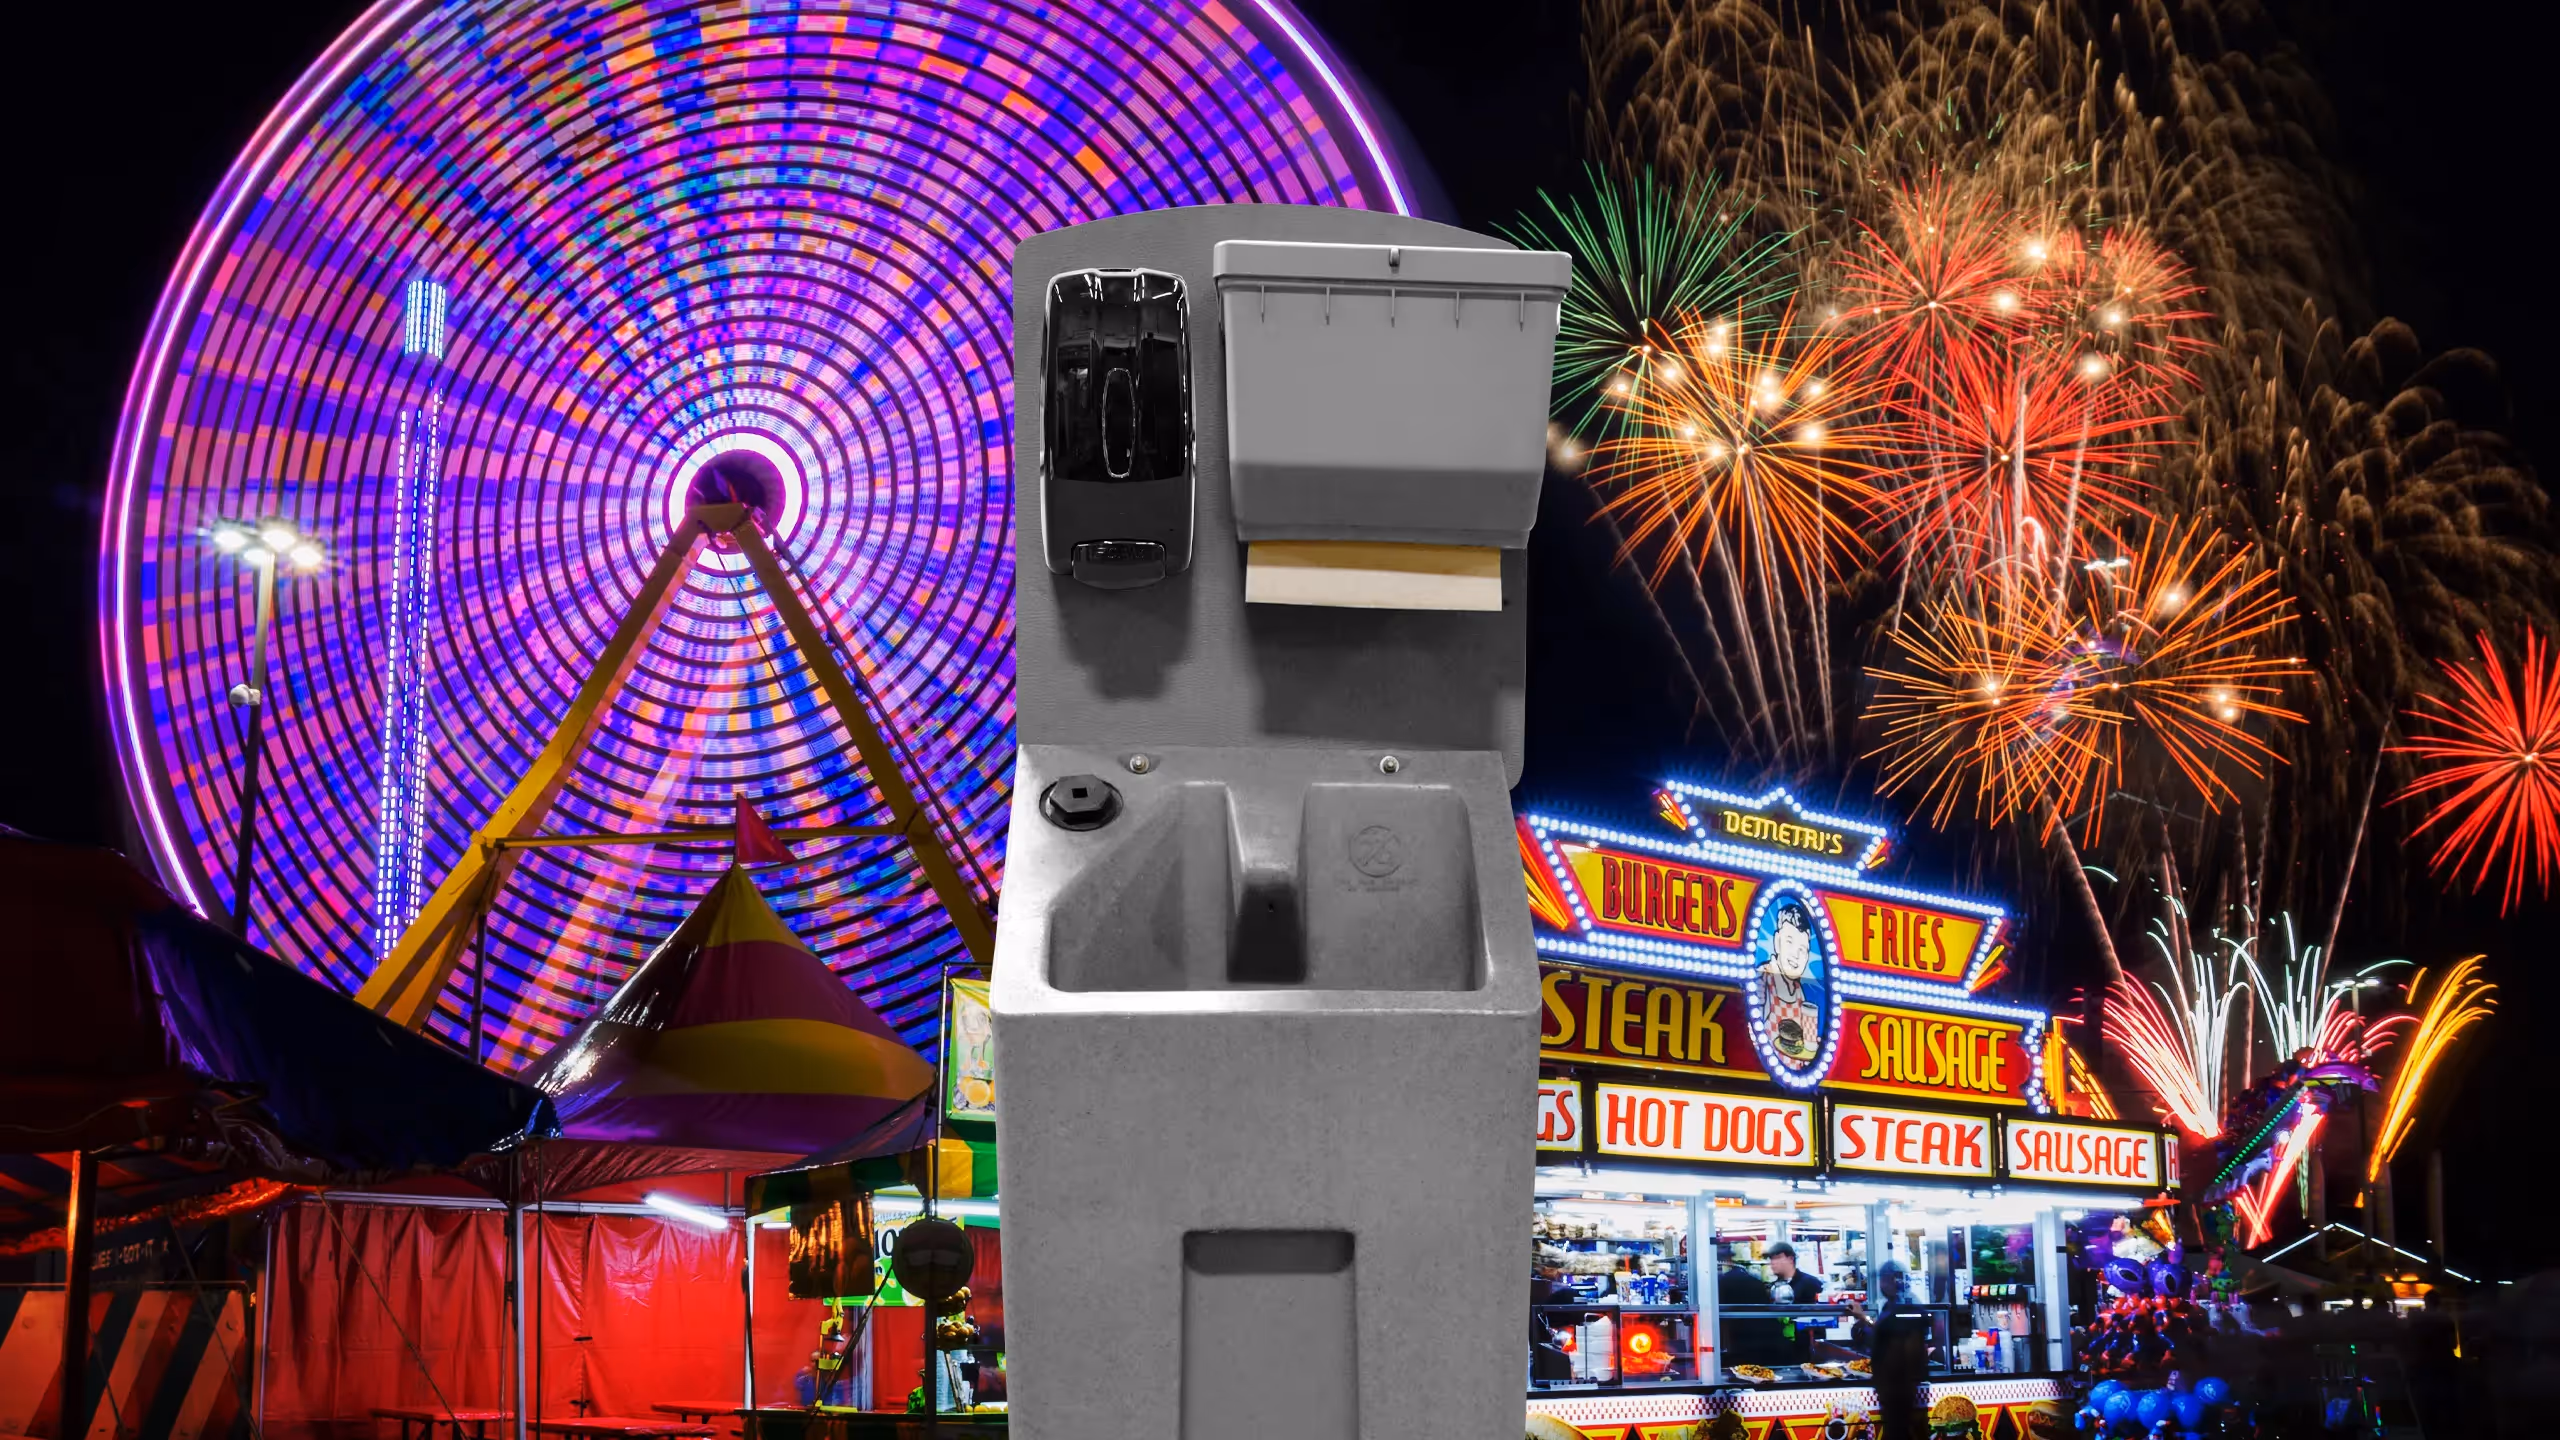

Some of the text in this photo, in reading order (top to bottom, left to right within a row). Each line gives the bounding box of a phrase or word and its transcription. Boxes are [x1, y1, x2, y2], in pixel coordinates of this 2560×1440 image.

[1723, 810, 1843, 854] DEMETRI'S
[1602, 856, 1737, 938] BURGERS
[1862, 904, 1946, 972] FRIES
[1540, 971, 1727, 1065] STEAK
[1859, 1014, 2008, 1093] SAUSAGE
[1606, 1093, 1805, 1157] HOT DOGS
[1840, 1114, 1983, 1169] STEAK
[2015, 1128, 2149, 1179] SAUSAGE
